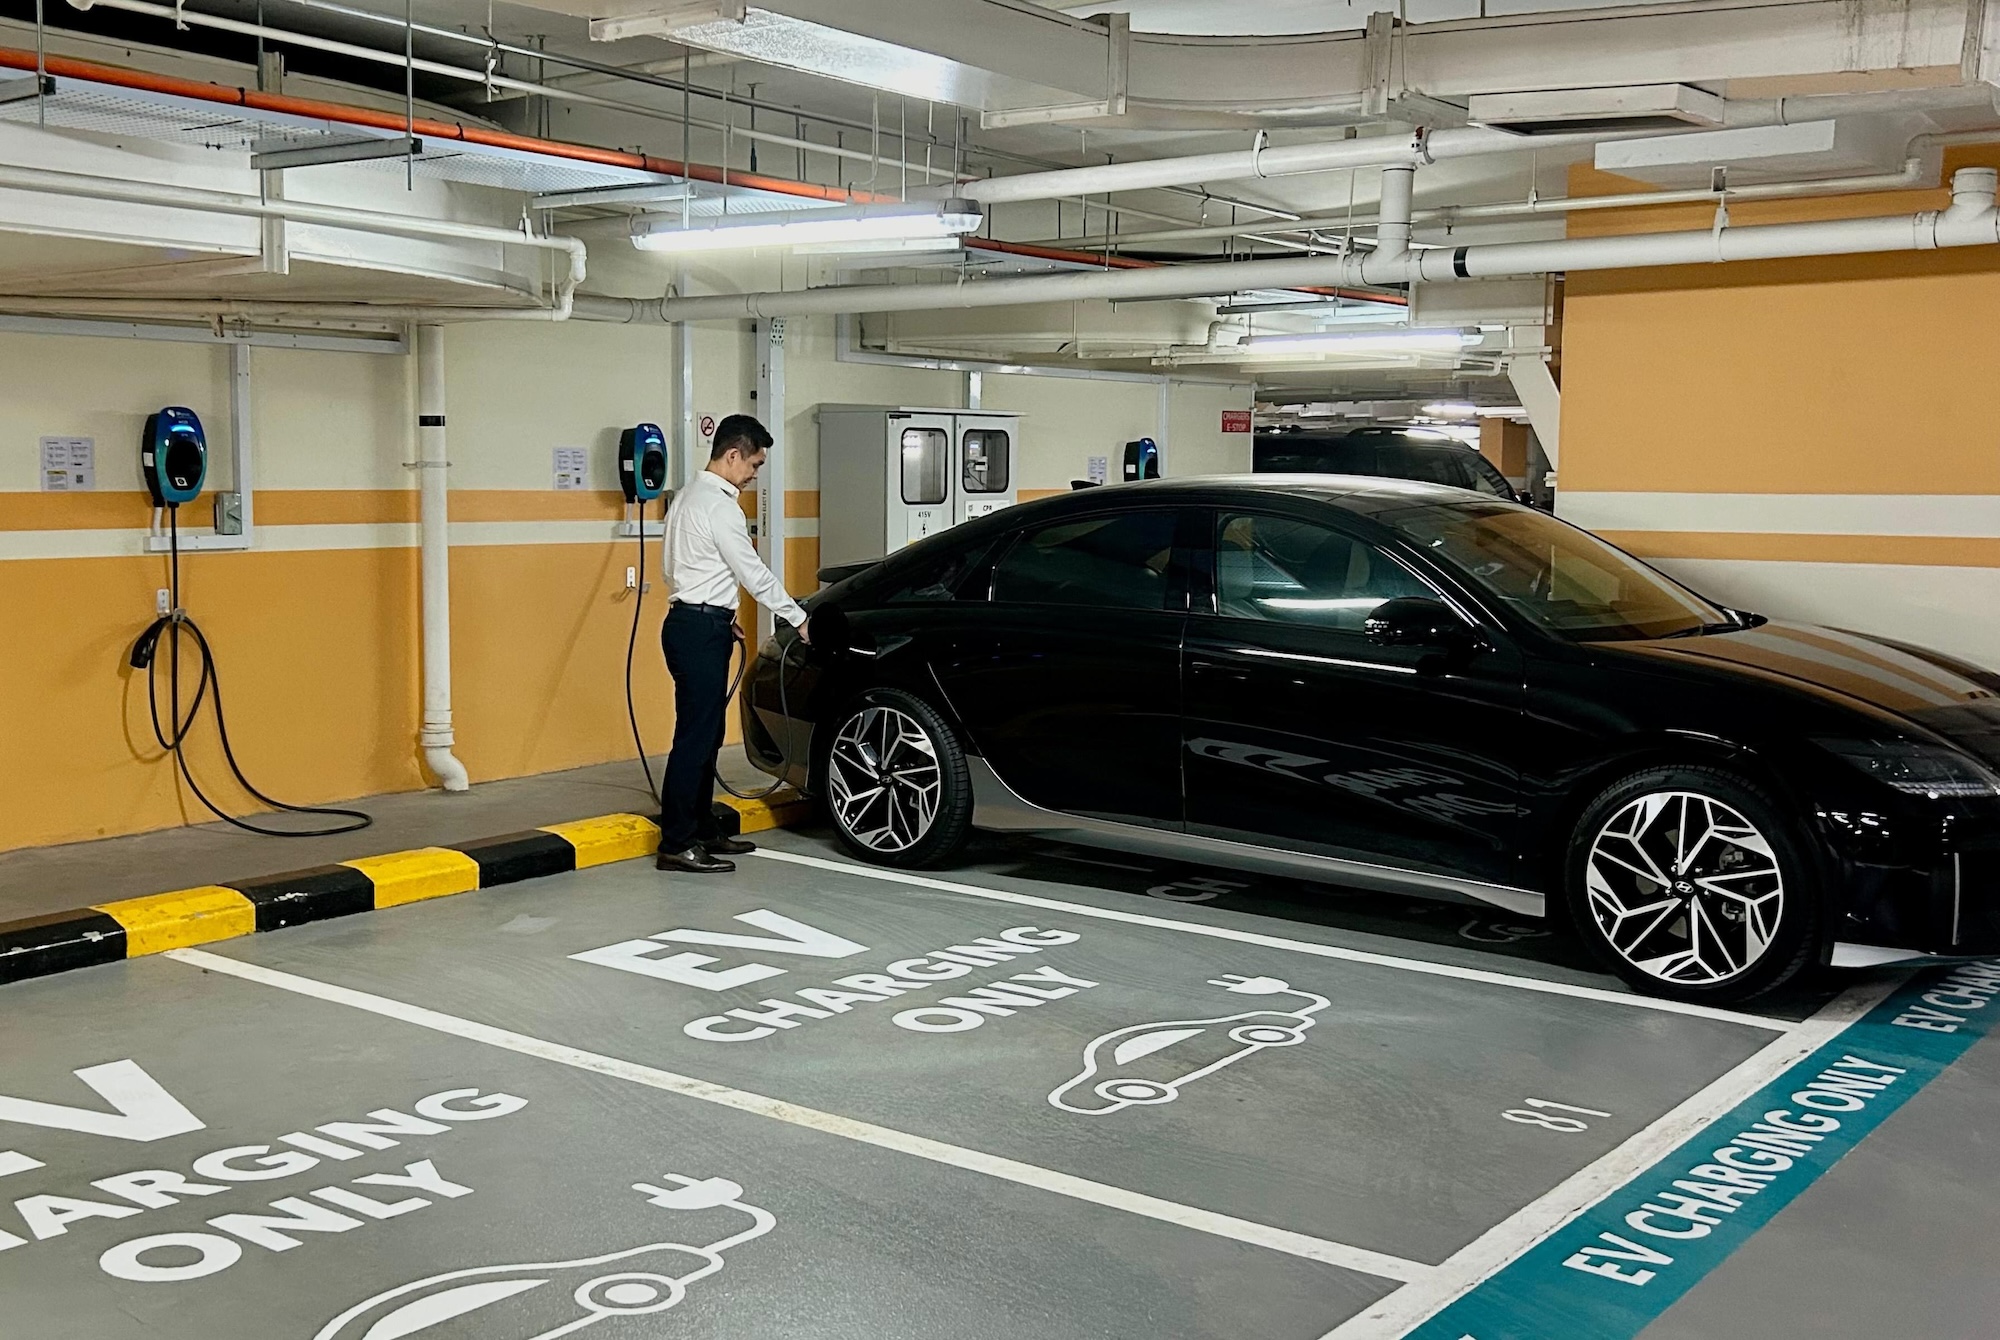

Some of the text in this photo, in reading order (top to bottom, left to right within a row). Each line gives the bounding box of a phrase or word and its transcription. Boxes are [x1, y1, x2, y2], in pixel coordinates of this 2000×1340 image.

[1226, 422, 1247, 432] E-STOP
[566, 907, 871, 992] EV
[683, 926, 1081, 1042] CHARGING
[891, 965, 1100, 1033] ONLY
[1890, 1004, 1968, 1034] EV
[0, 1058, 207, 1177] V
[1500, 1097, 1612, 1133] 81
[0, 1087, 529, 1251] ARGING
[1562, 1054, 1907, 1287] EV CHARGING ONLY
[99, 1158, 475, 1282] ONLY
